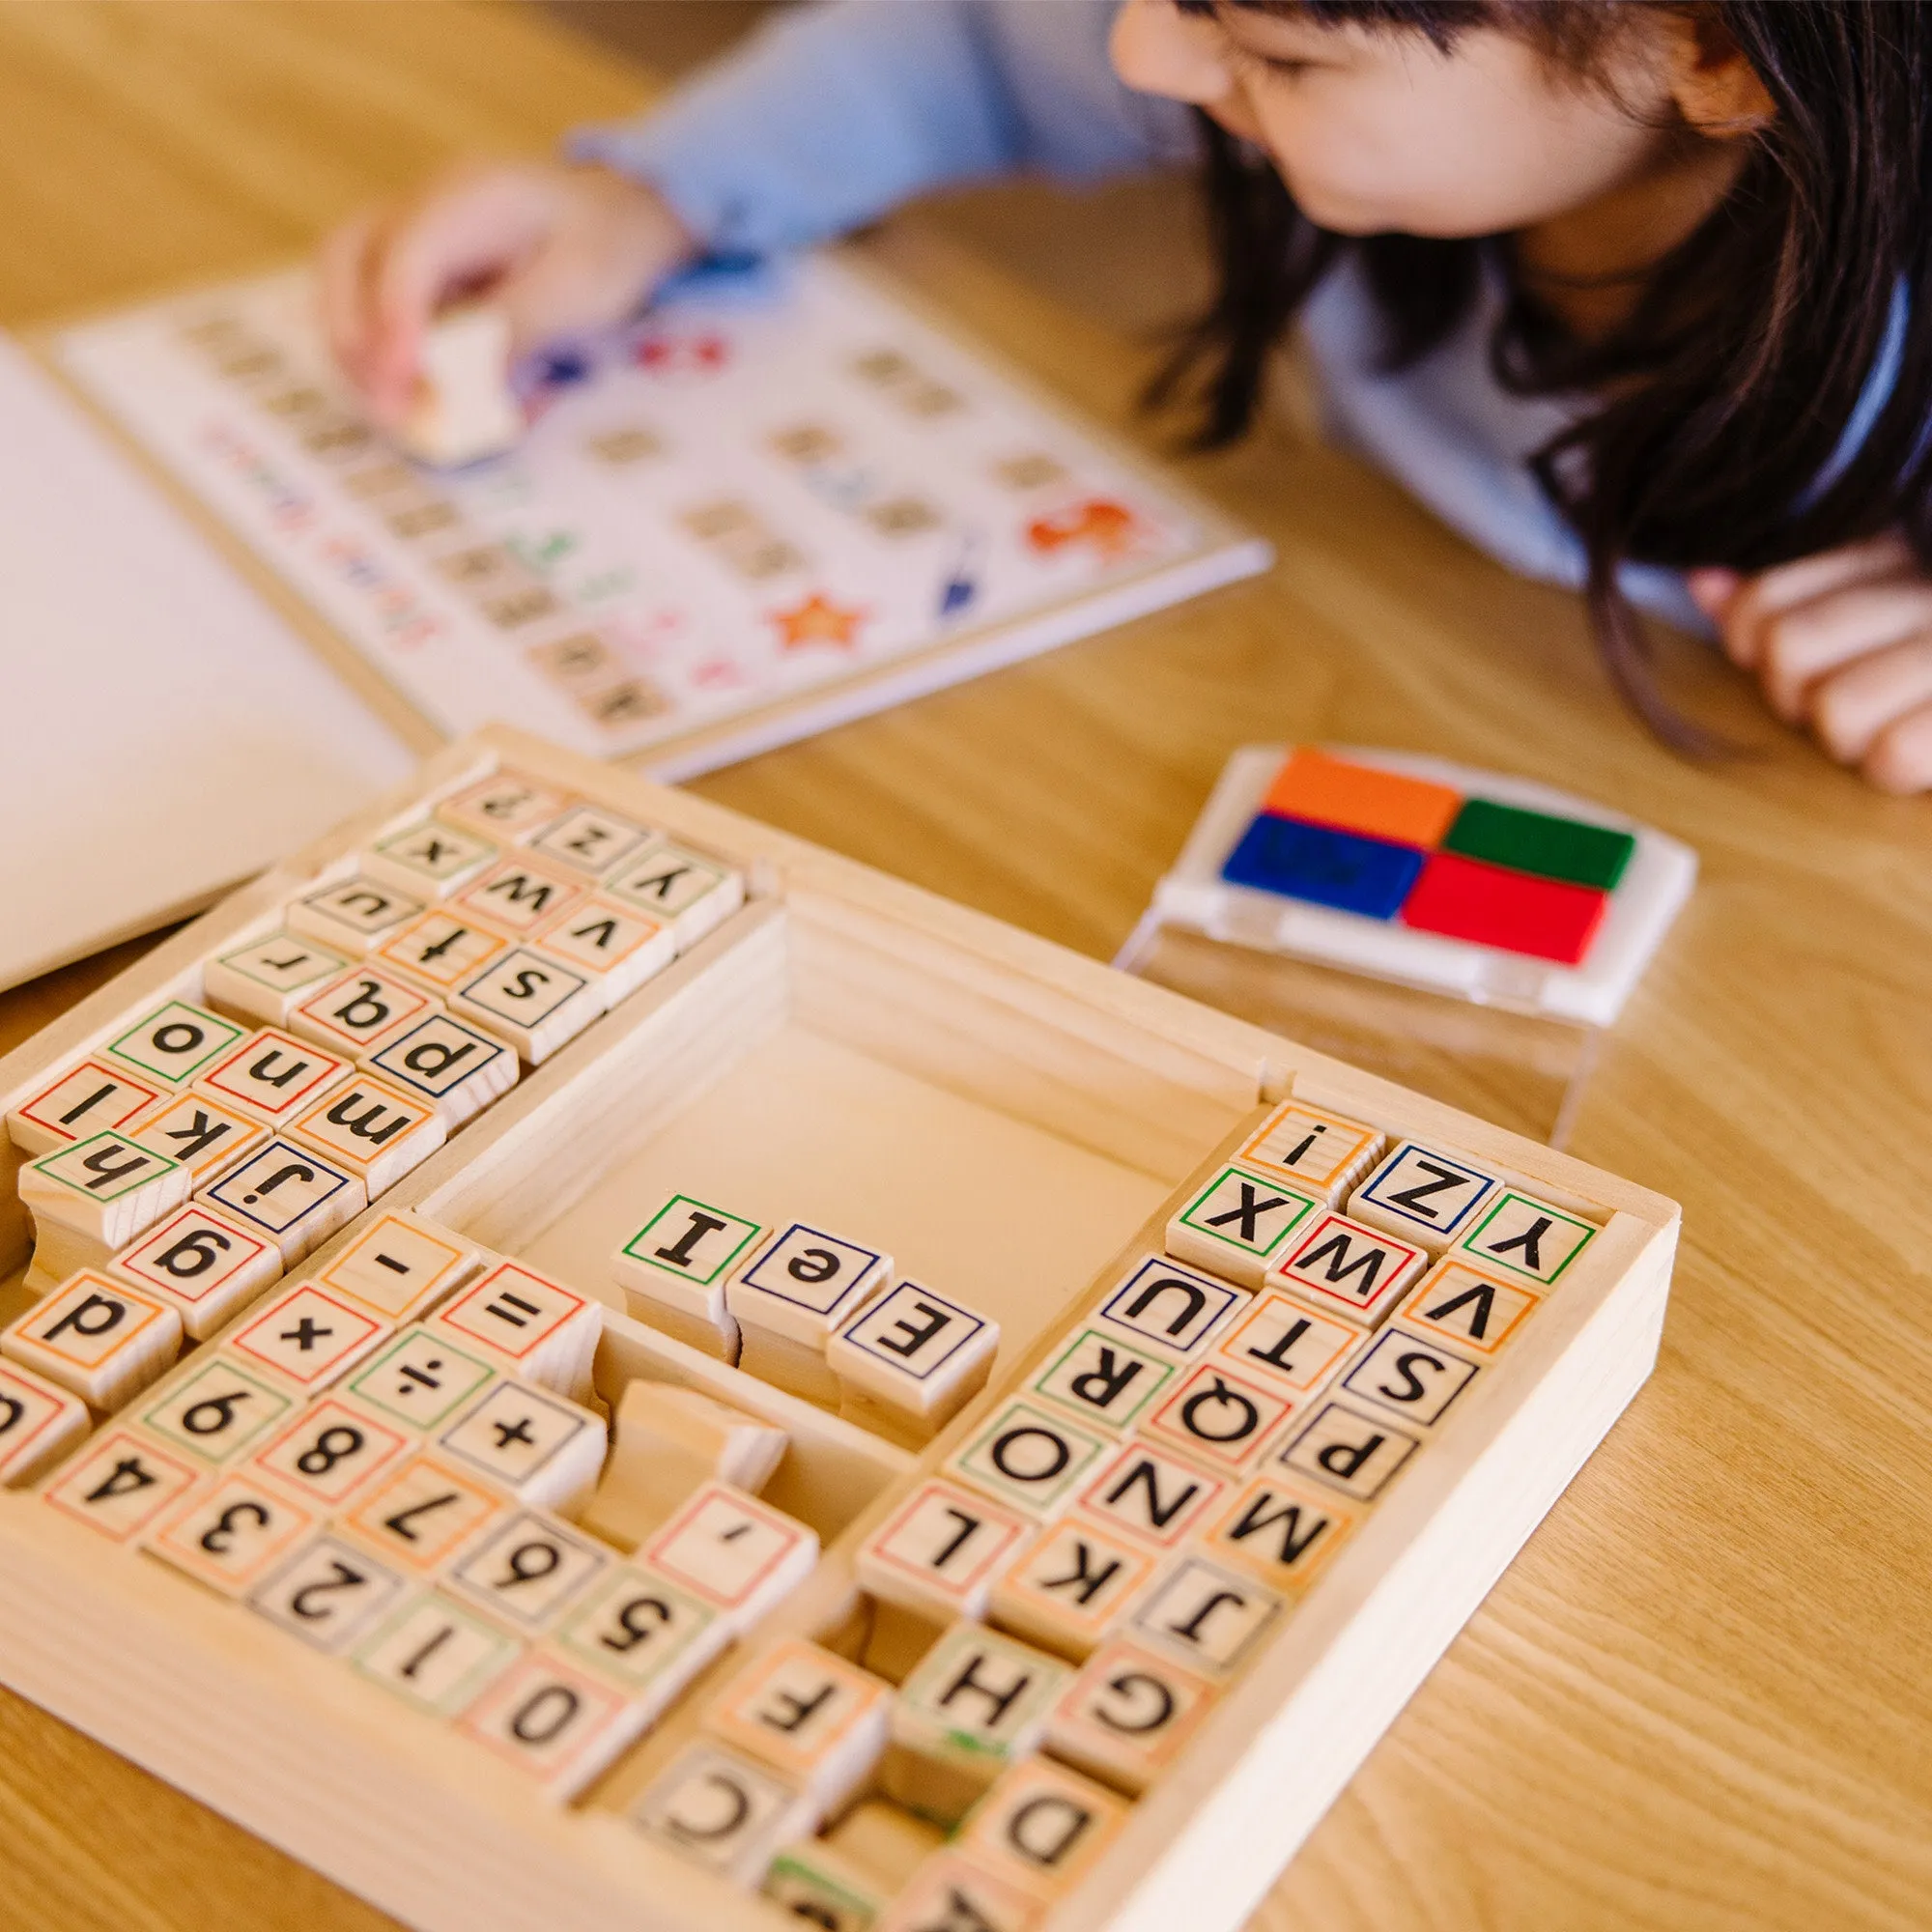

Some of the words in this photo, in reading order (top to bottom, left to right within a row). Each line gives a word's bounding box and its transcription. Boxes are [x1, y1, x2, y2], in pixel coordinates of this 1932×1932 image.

[637, 868, 688, 897] y
[420, 929, 466, 962] t
[166, 1111, 231, 1161] k
[327, 1094, 411, 1145] m
[83, 1145, 150, 1189] h
[243, 1163, 315, 1205] j
[1388, 1160, 1471, 1219] Z
[1208, 1182, 1289, 1242] X
[154, 1230, 230, 1277] g
[653, 1211, 727, 1267] I
[1294, 1235, 1386, 1295] W
[1488, 1217, 1552, 1270] Y
[788, 1249, 839, 1283] e
[877, 1302, 952, 1357] E
[1124, 1279, 1206, 1336] U
[1425, 1284, 1495, 1340] V
[1248, 1320, 1311, 1371] T
[1071, 1348, 1143, 1407] R
[1379, 1352, 1445, 1402] S
[1181, 1378, 1258, 1442] Q
[298, 1427, 363, 1475] 8
[1318, 1435, 1385, 1479] P
[86, 1459, 155, 1502] 4
[1107, 1462, 1198, 1527] N
[201, 1503, 269, 1553] 3
[384, 1494, 457, 1541] 7
[931, 1507, 982, 1570] L
[1230, 1493, 1327, 1565] M
[292, 1562, 365, 1619] 2
[1044, 1544, 1121, 1605] K
[602, 1599, 670, 1652] 5
[1172, 1592, 1244, 1642] J
[763, 1686, 835, 1732] F
[940, 1656, 1029, 1726] H
[1097, 1674, 1175, 1734] G
[670, 1776, 750, 1840] C
[1008, 1798, 1094, 1867] D
